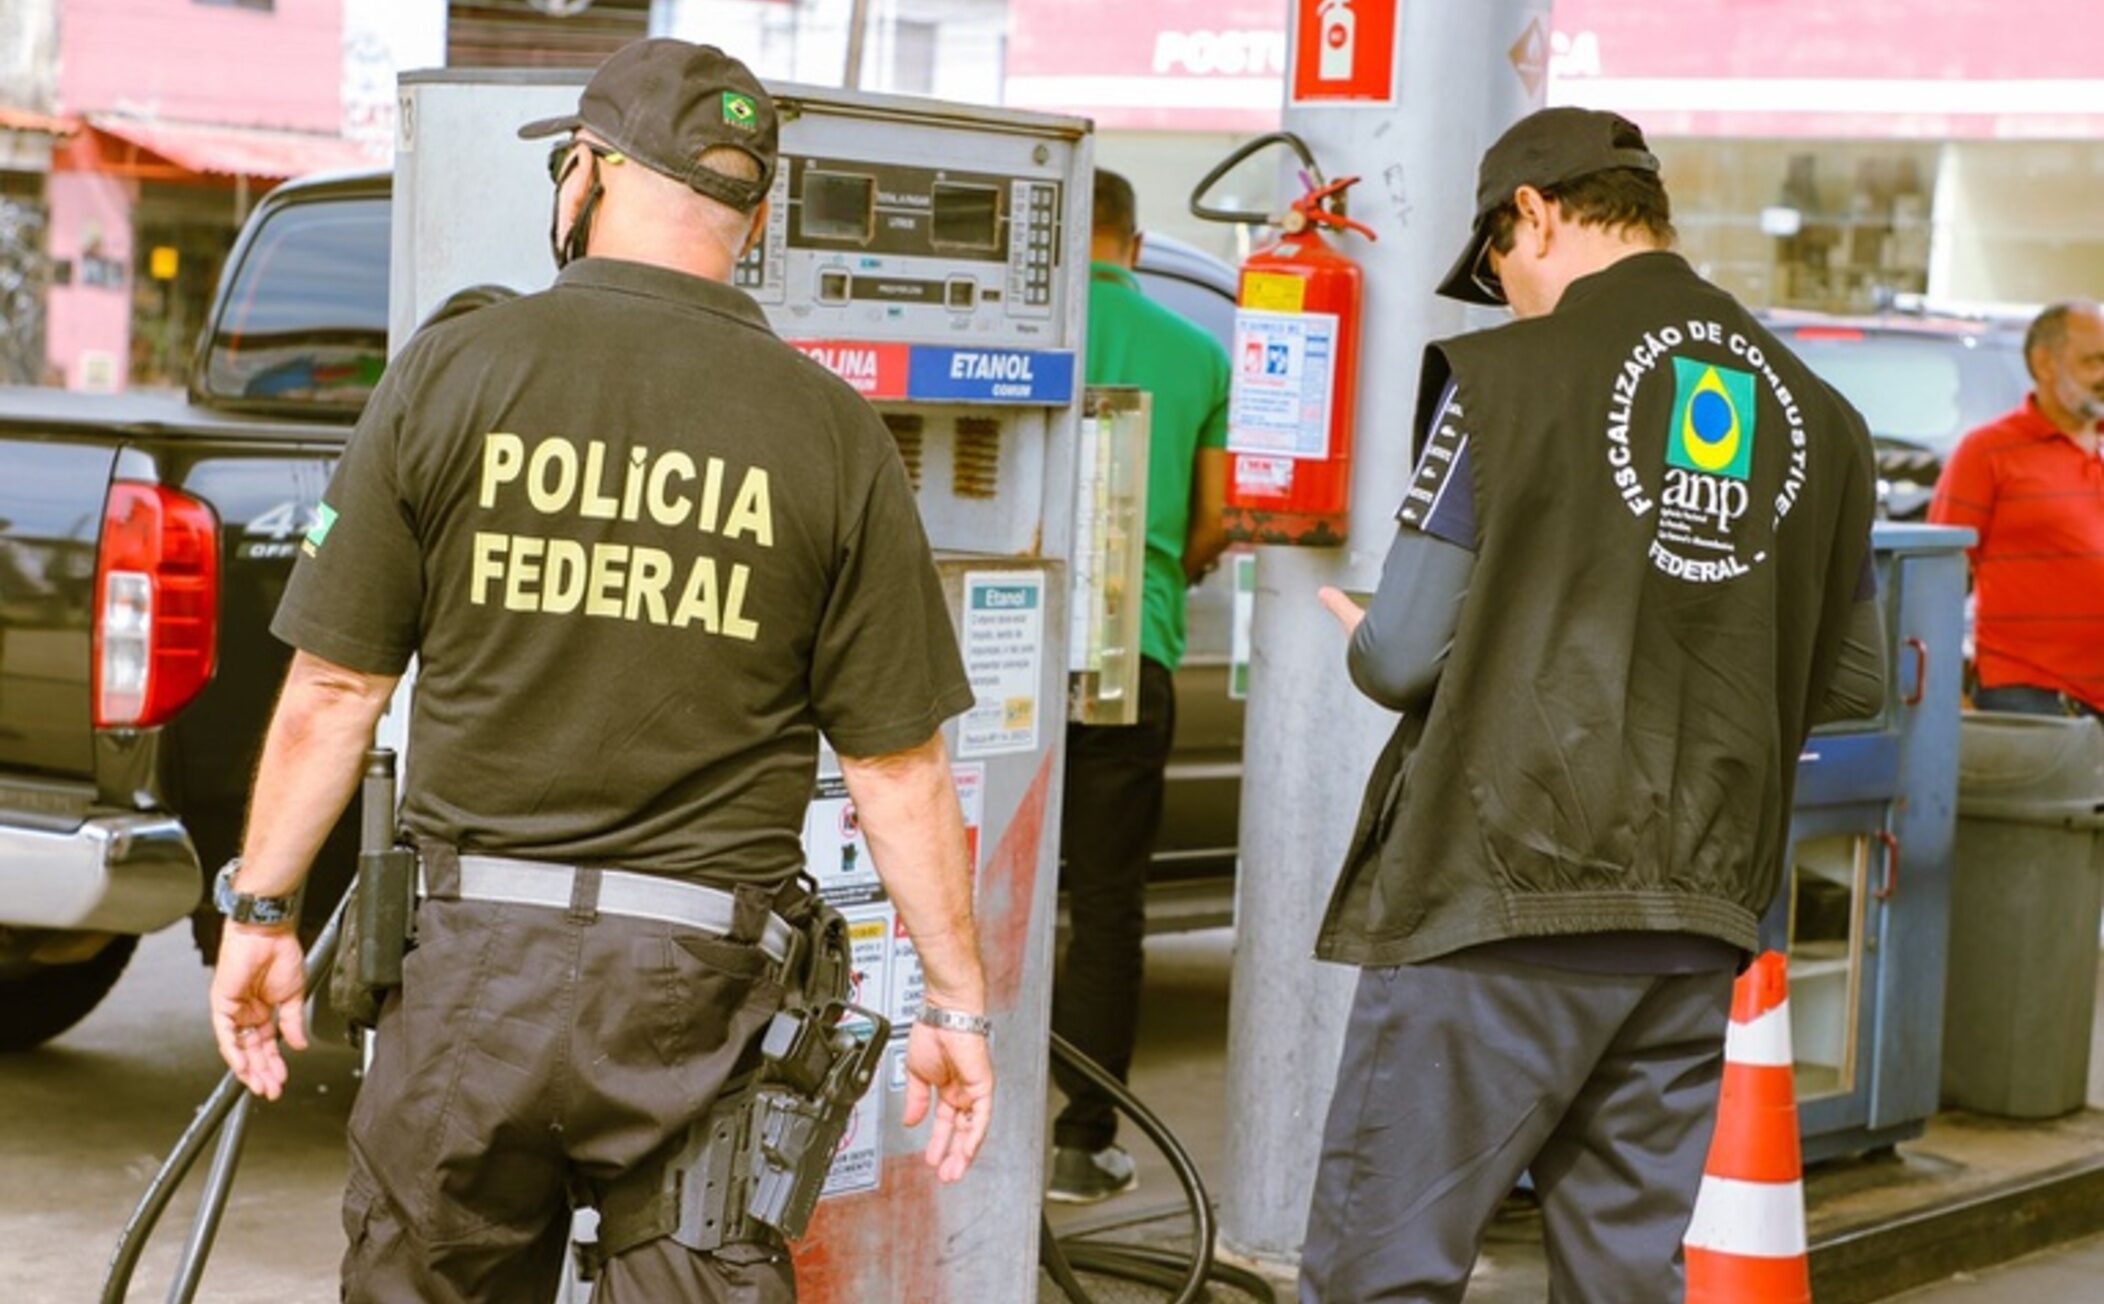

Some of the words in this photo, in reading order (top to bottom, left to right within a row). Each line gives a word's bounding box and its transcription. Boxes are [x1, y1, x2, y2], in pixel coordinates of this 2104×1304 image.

[797, 347, 877, 377] OLINA
[950, 351, 1034, 382] ETANOL
[1608, 327, 1682, 516] FISCALIZAÇÃO
[1687, 320, 1723, 344] DE
[1661, 468, 1749, 533] anp
[248, 543, 295, 559] OFF
[1648, 539, 1750, 583] FEDERAL
[470, 531, 760, 642] FEDERAL
